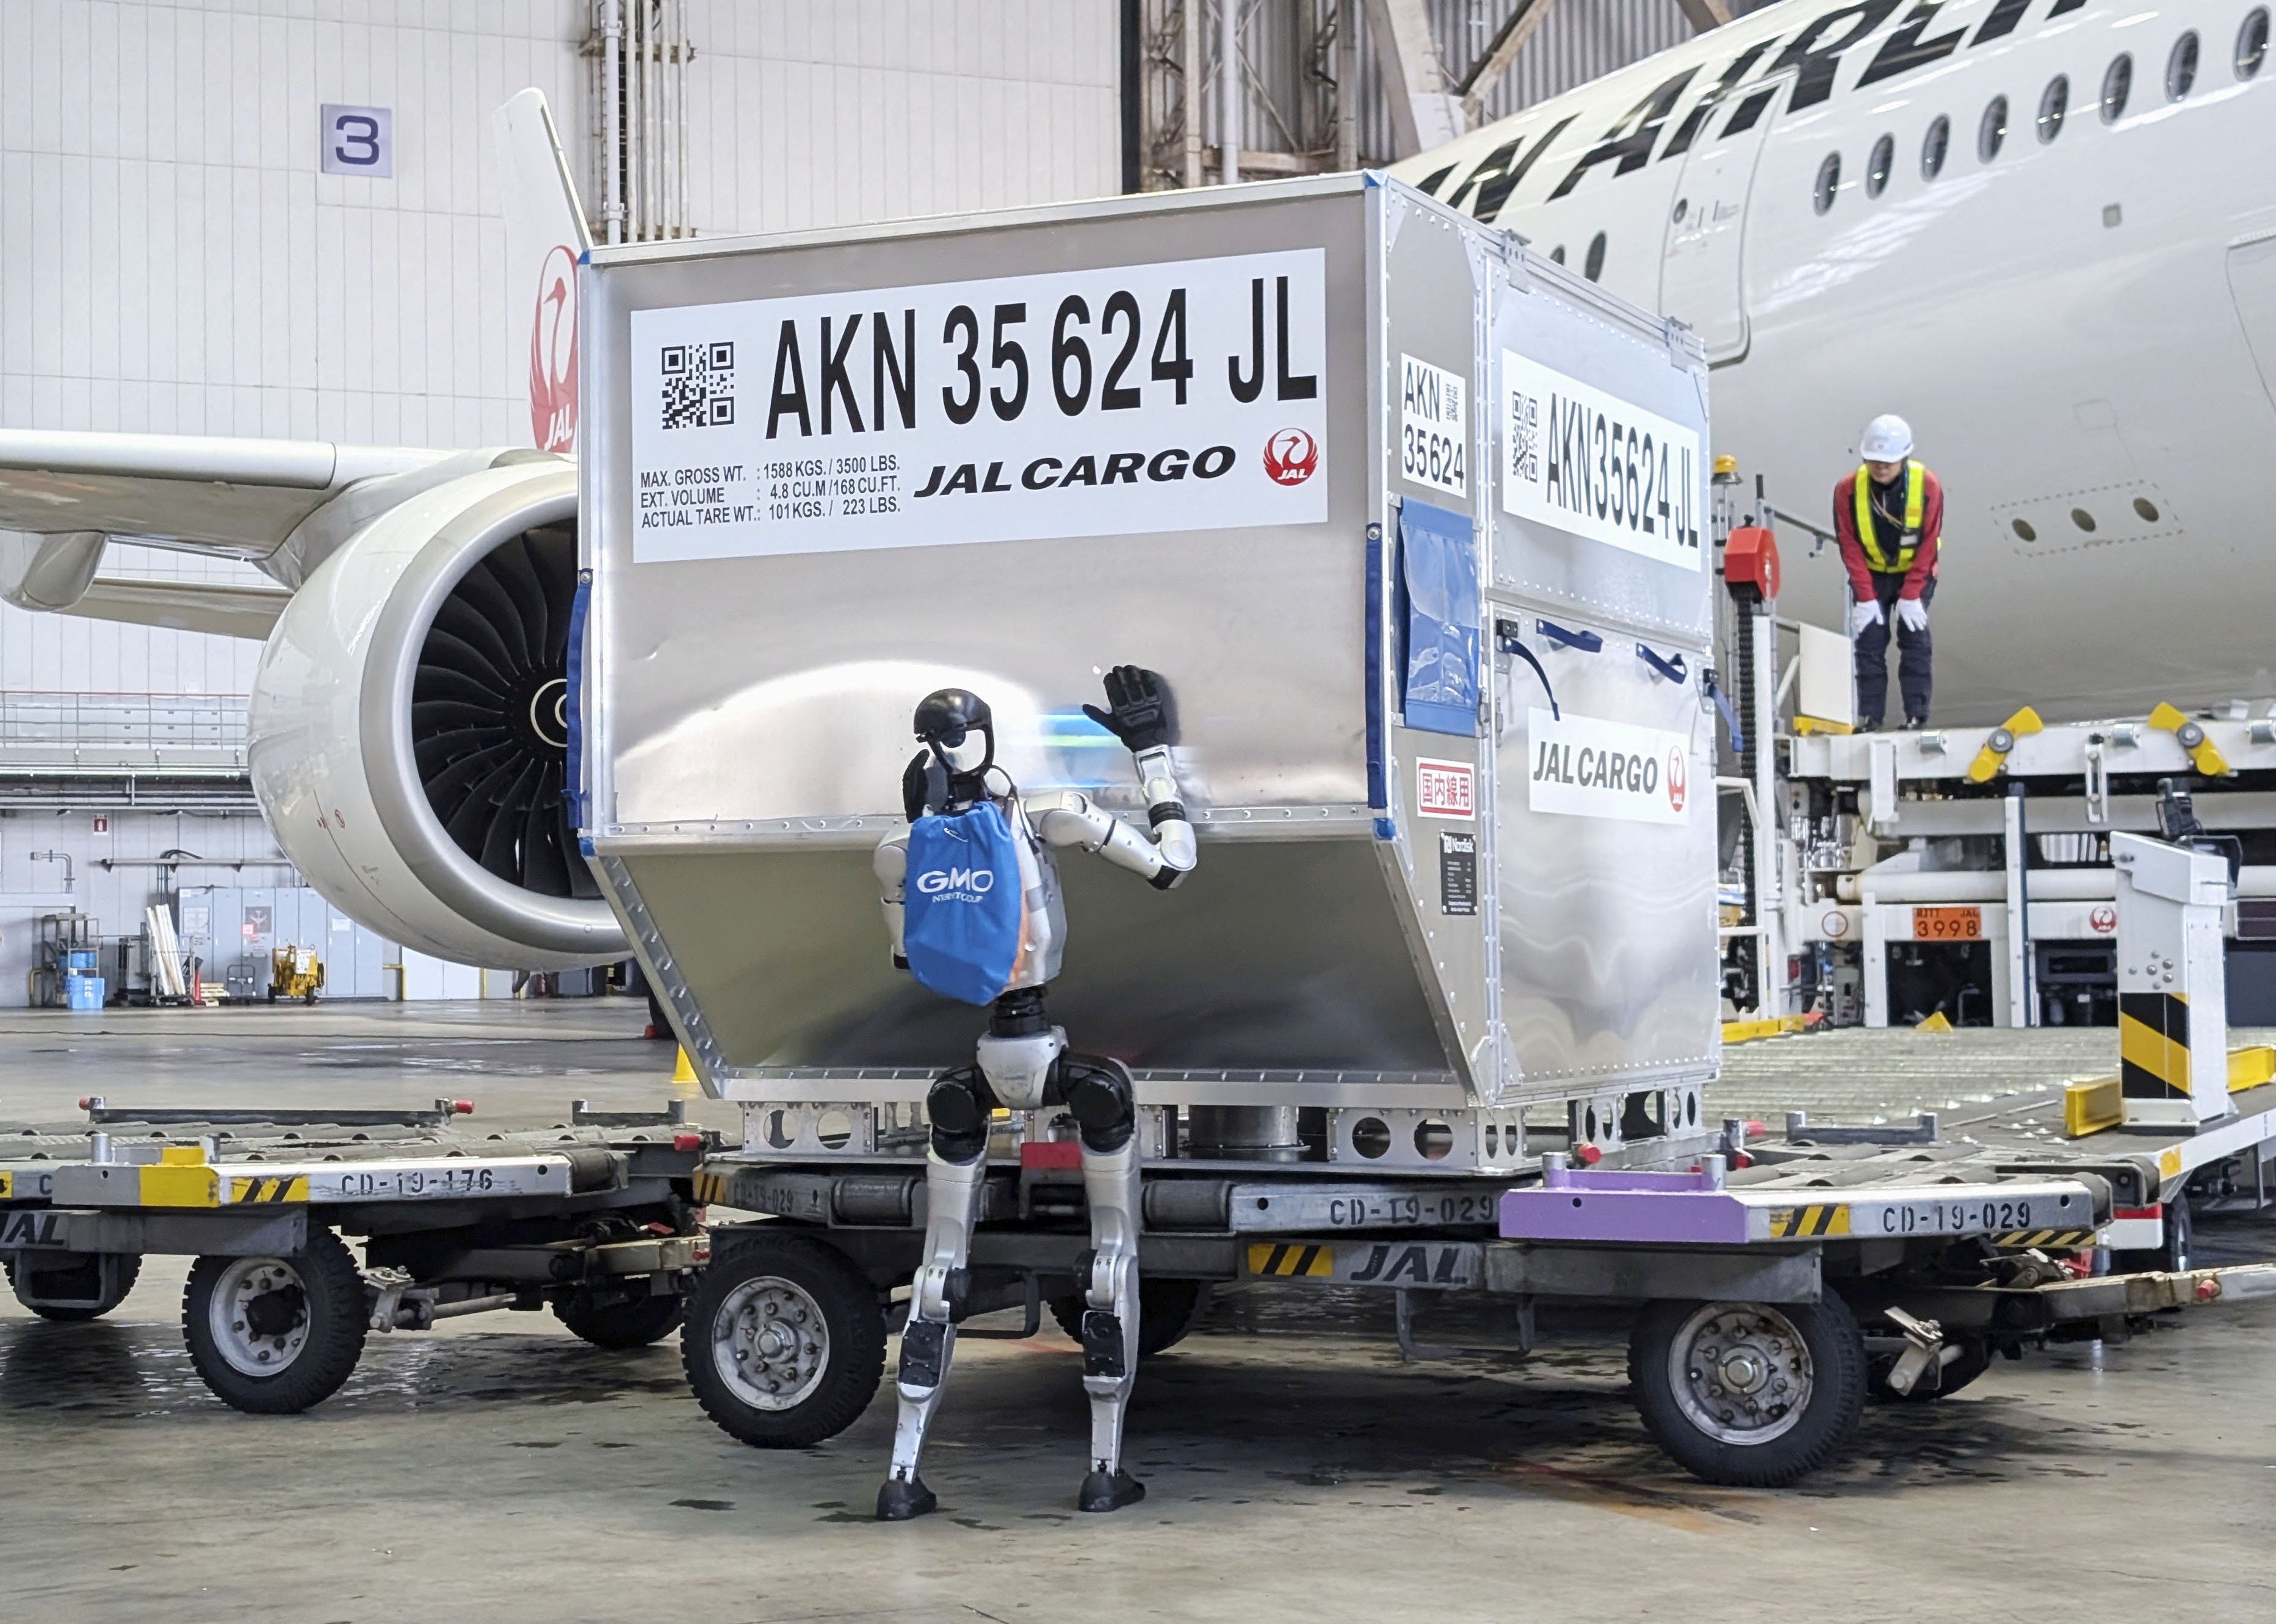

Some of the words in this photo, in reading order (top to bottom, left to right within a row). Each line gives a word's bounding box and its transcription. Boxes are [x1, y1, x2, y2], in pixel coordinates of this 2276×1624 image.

[336, 115, 379, 165] 3
[765, 308, 916, 439] AKN
[1228, 276, 1317, 403] JL
[1404, 362, 1440, 422] AKN
[544, 403, 573, 450] JAL
[641, 471, 671, 488] MAX.
[675, 467, 720, 485] GROSS
[764, 462, 793, 479] 1588
[836, 457, 867, 474] 3500
[870, 454, 900, 472] LBS.
[914, 461, 1011, 498] JAL
[1021, 445, 1236, 491] CARGO
[1277, 468, 1308, 480] JAL
[1404, 424, 1464, 489] 35624
[641, 491, 668, 508] EXT.
[671, 487, 724, 506] VOLUME
[770, 483, 789, 499] 4.8
[641, 510, 693, 528] ACTUAL
[696, 507, 730, 524] TARE
[769, 502, 789, 520] 101
[843, 498, 865, 515] 223
[870, 496, 900, 514] LBS.
[1533, 741, 1574, 784] JAL
[1578, 747, 1658, 794] CARGO
[1423, 773, 1469, 807] 国内線用
[917, 867, 994, 893] GMO
[1918, 920, 1978, 937] 3998
[1883, 1201, 2031, 1232] CD-19-029
[1349, 1246, 1469, 1283] JAL
